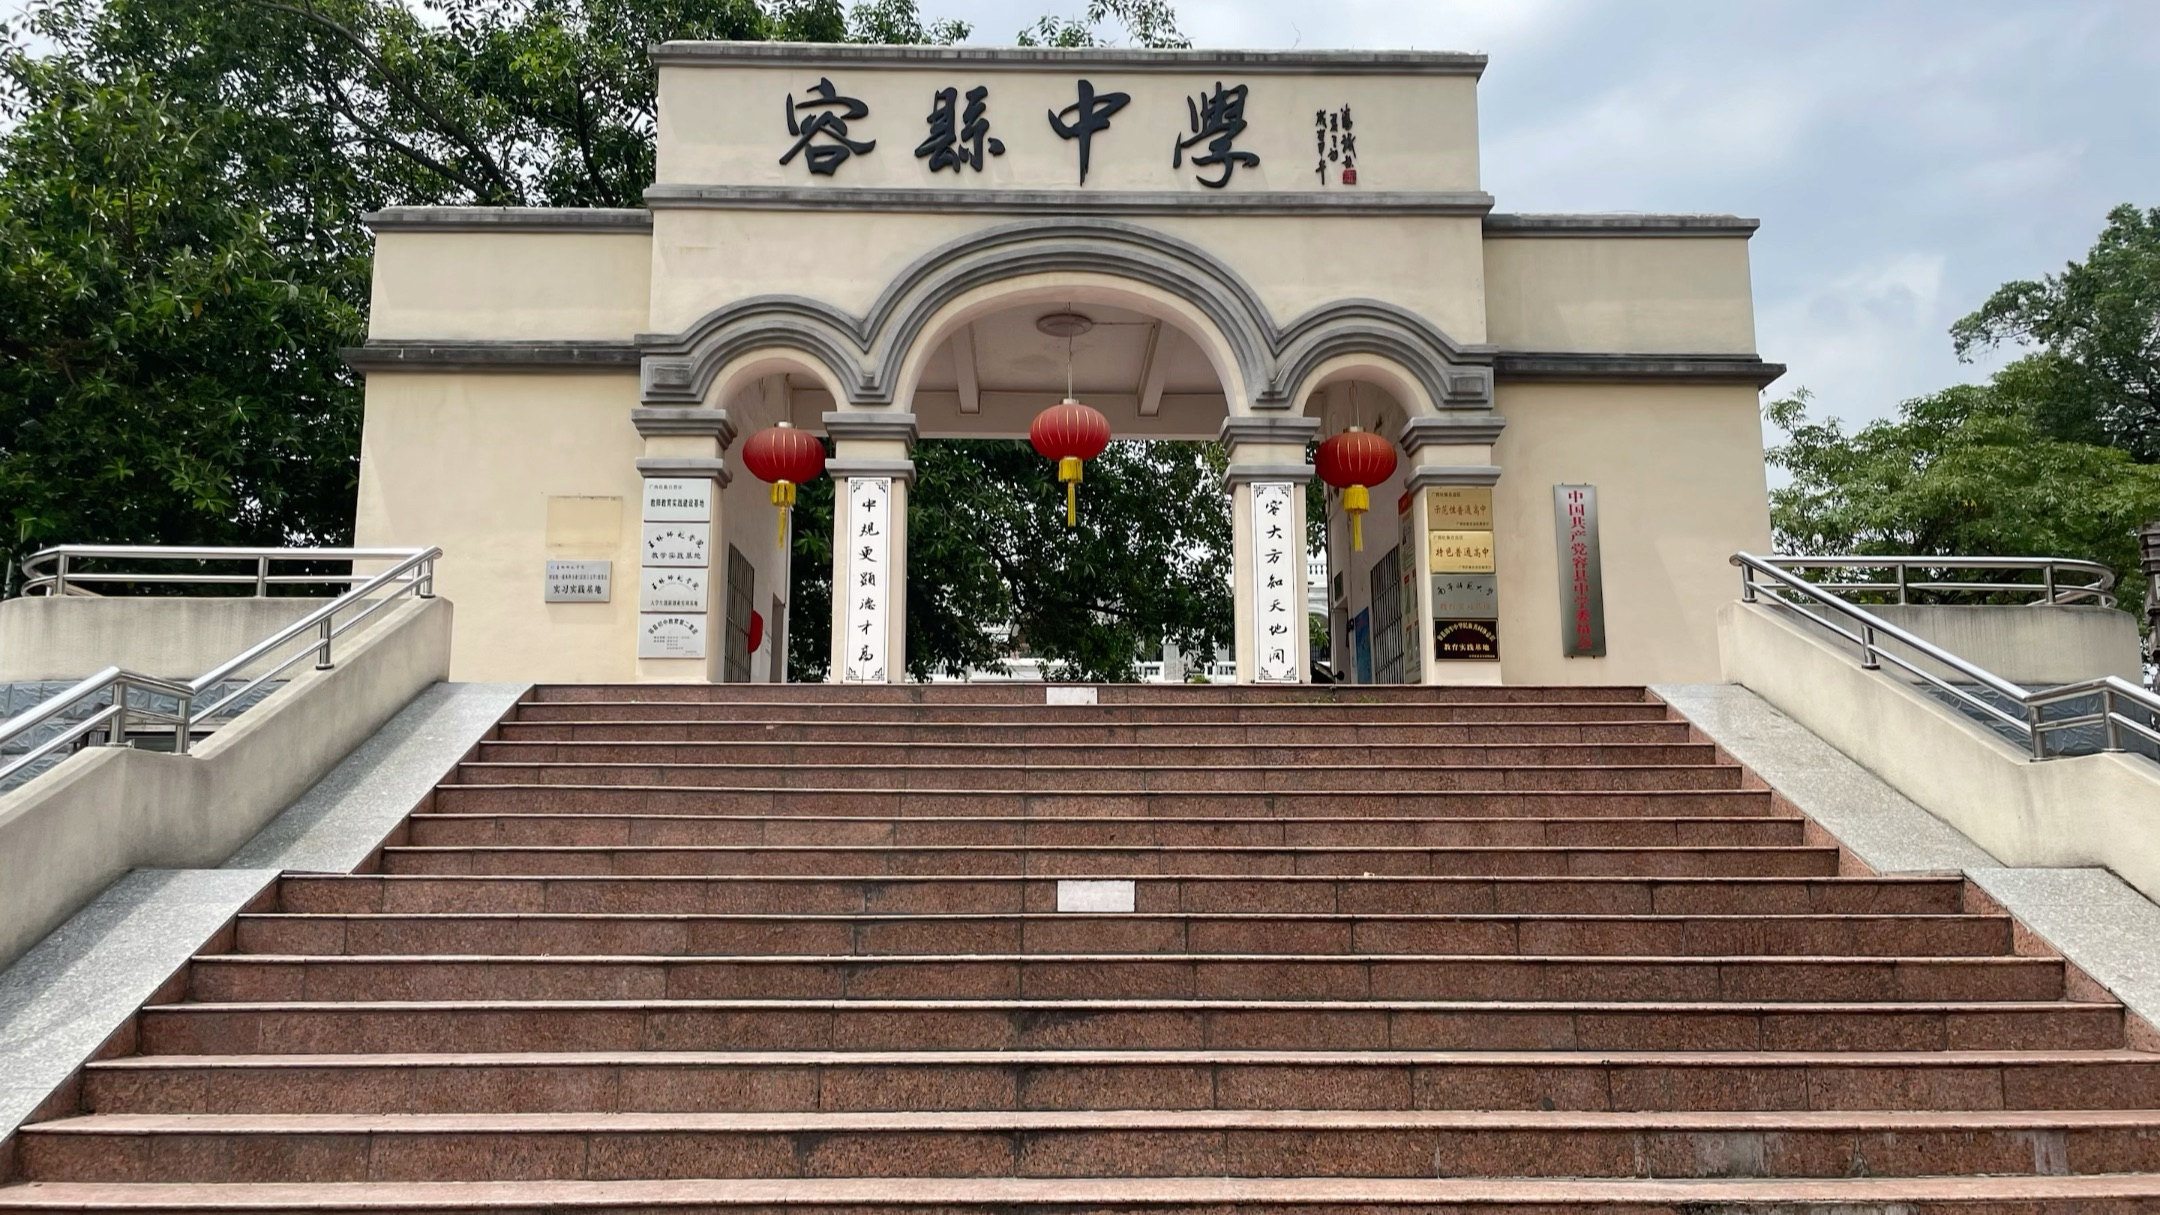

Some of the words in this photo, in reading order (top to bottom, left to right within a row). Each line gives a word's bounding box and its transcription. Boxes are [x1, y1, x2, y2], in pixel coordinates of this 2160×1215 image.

[1434, 504, 1486, 516] 示范性普通高中
[1435, 546, 1489, 559] 特色普通高中
[1568, 490, 1592, 650] 中国共产党容县中学委员会
[553, 584, 602, 594] 实习实践基地
[1444, 643, 1490, 651] 教育实践基地
